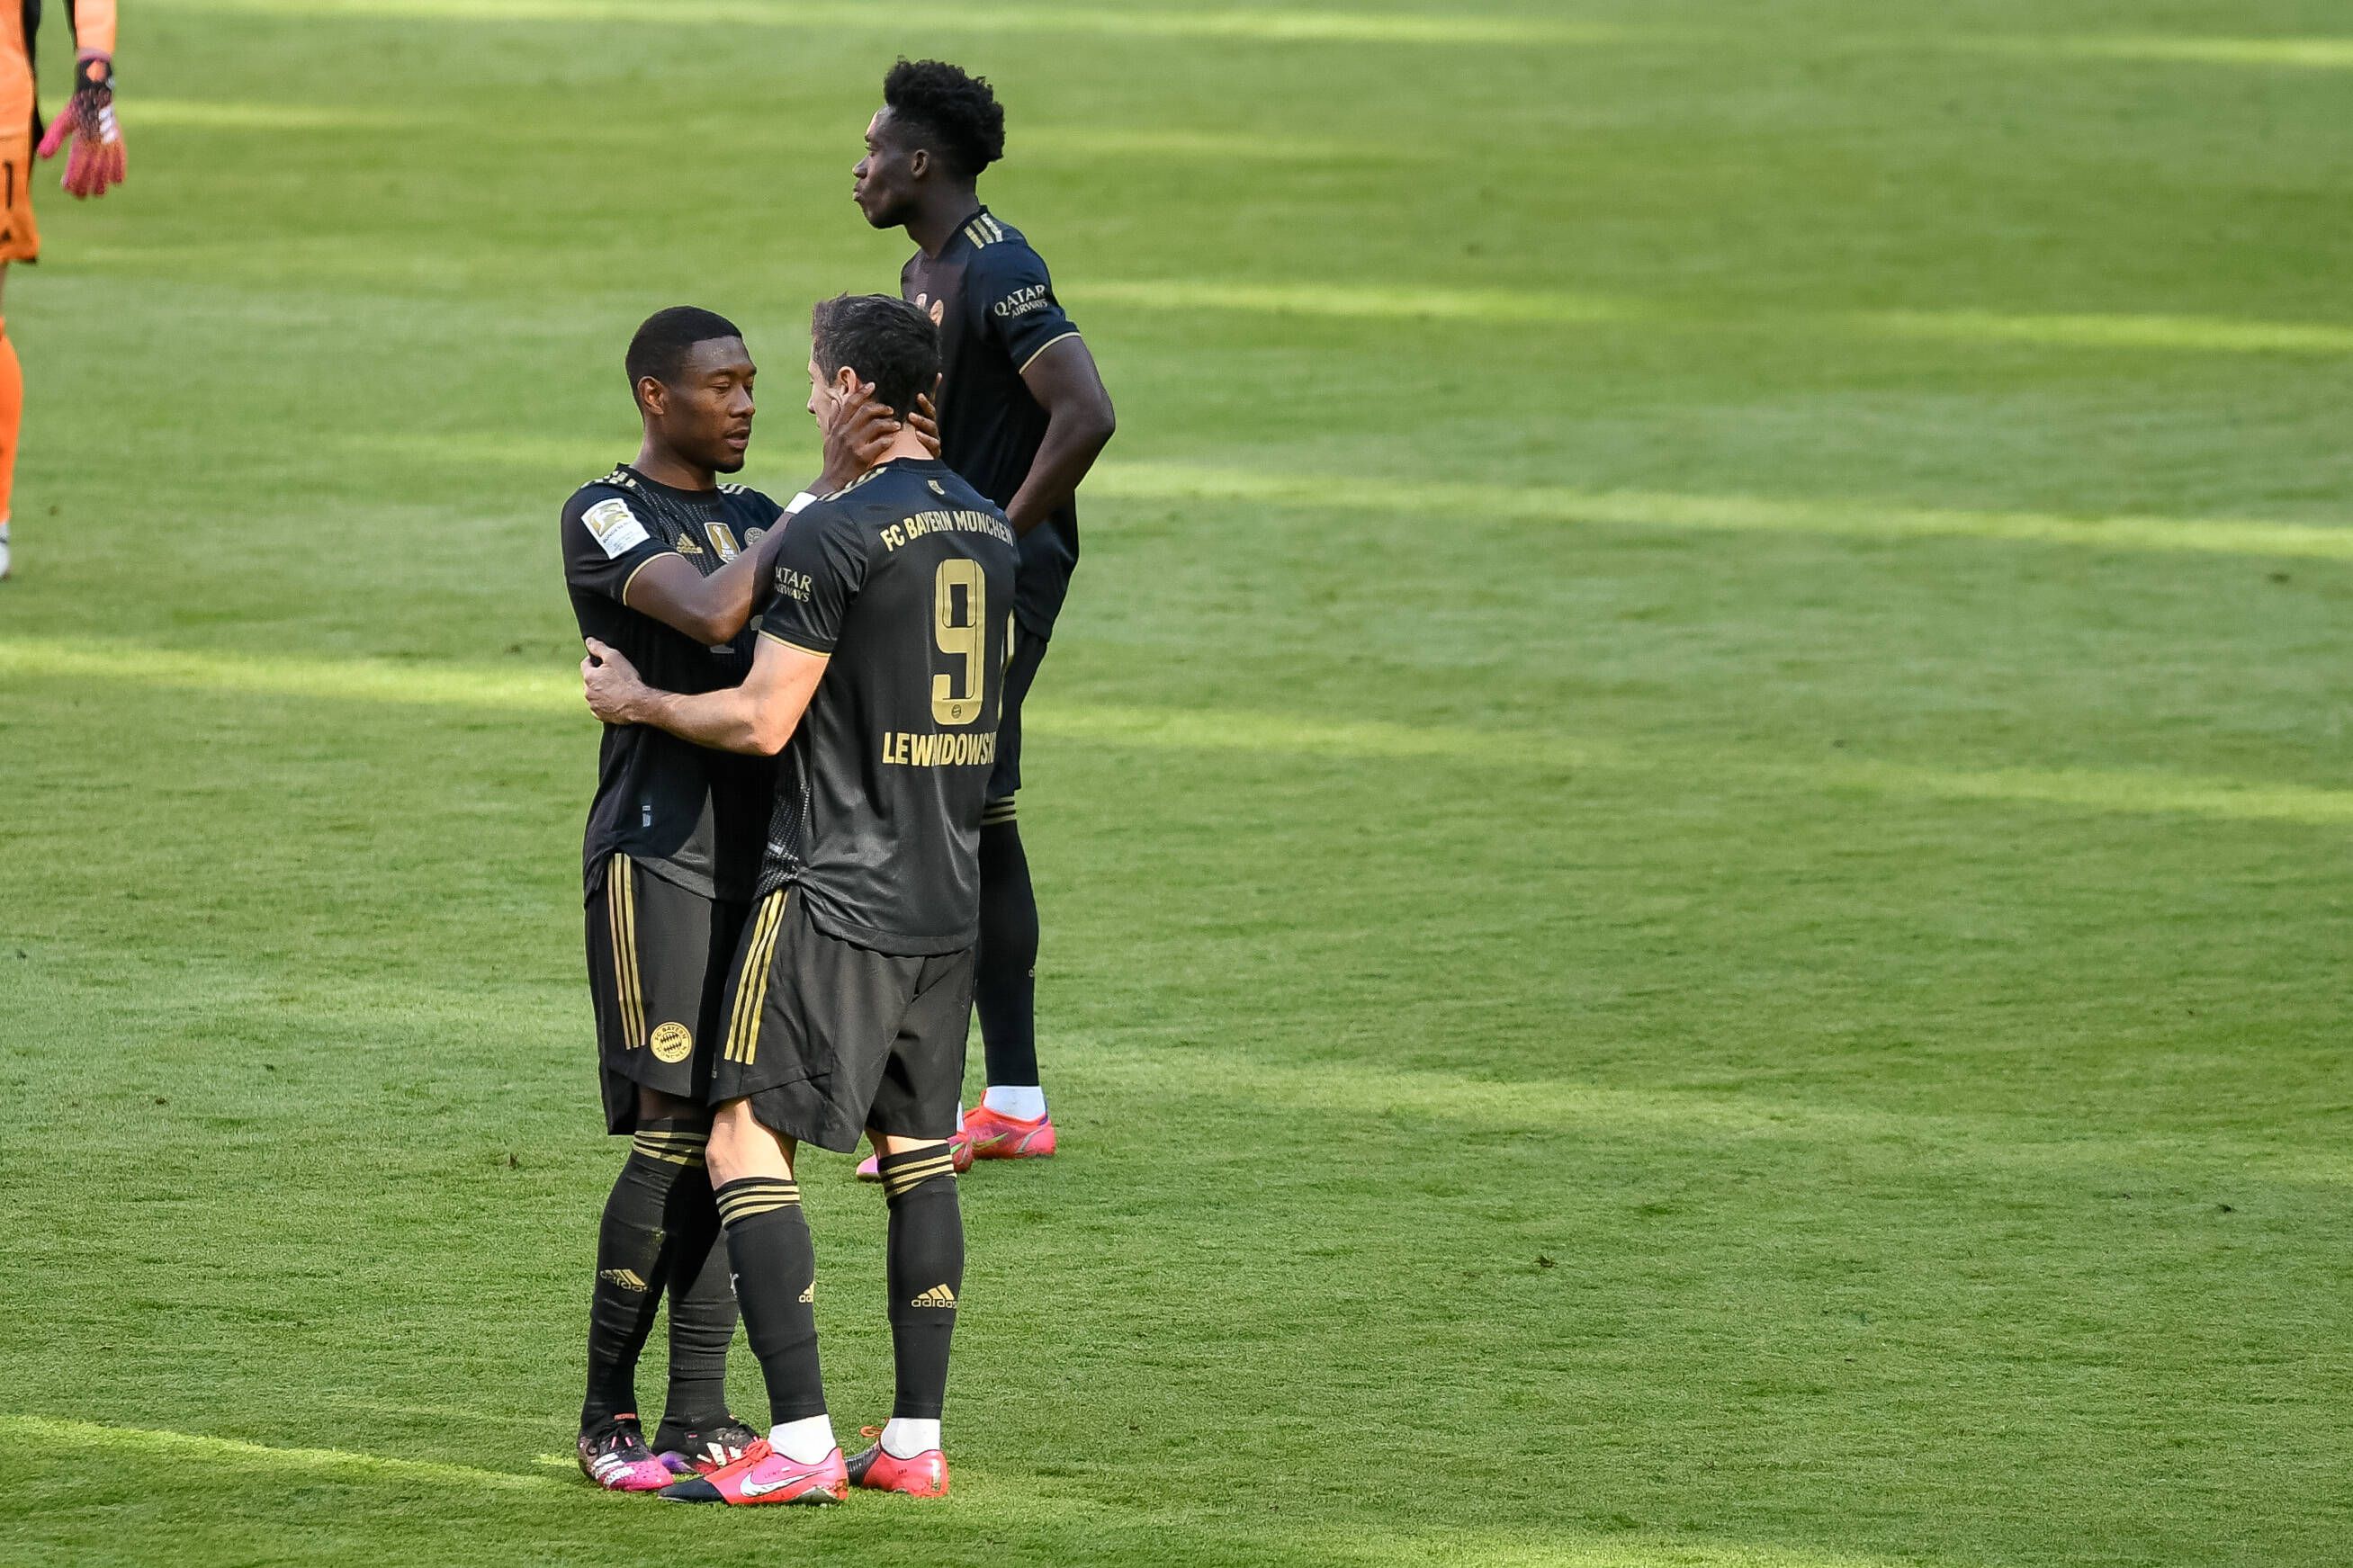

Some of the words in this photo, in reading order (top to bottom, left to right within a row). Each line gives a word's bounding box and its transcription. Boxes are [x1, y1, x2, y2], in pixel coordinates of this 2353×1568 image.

[994, 284, 1046, 316] QATAR
[1011, 298, 1048, 318] AIRWAYS
[880, 524, 905, 551] FC
[903, 511, 954, 540] BAYERN
[775, 566, 813, 593] ATAR
[931, 559, 985, 725] 9
[911, 1296, 957, 1309] adidas
